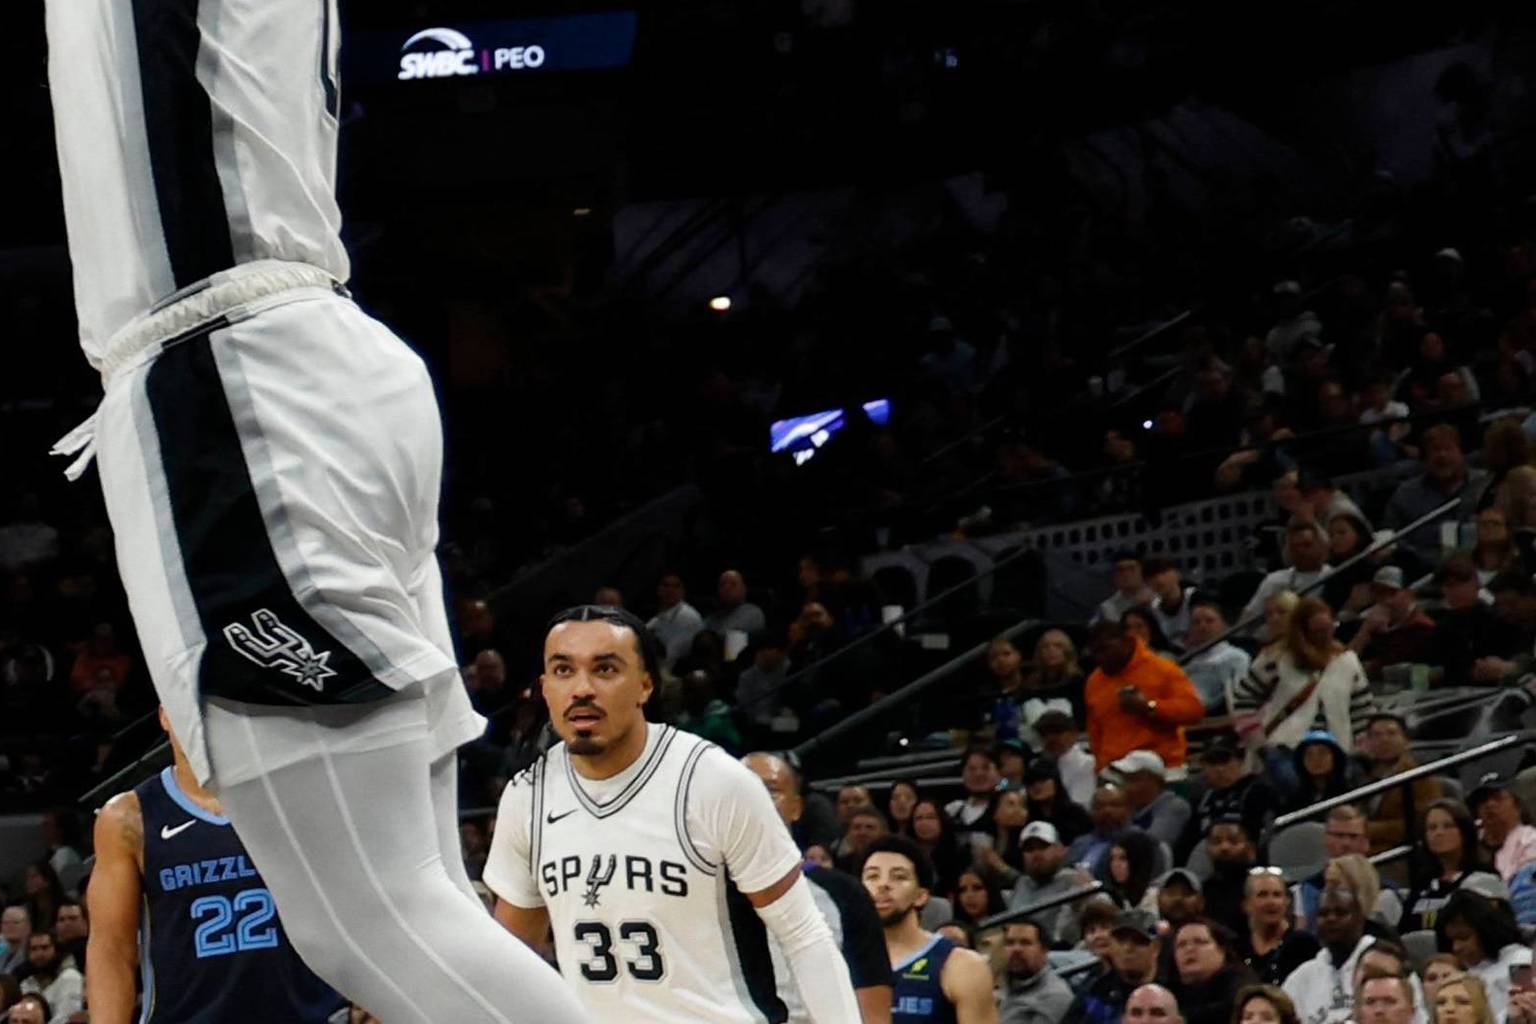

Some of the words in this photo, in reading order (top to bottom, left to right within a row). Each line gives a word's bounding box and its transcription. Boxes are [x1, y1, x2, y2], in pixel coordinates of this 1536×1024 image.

[398, 49, 479, 80] SWBC
[494, 45, 545, 70] PEO
[541, 854, 689, 909] SPURS
[190, 888, 278, 958] 22
[574, 920, 666, 983] 33
